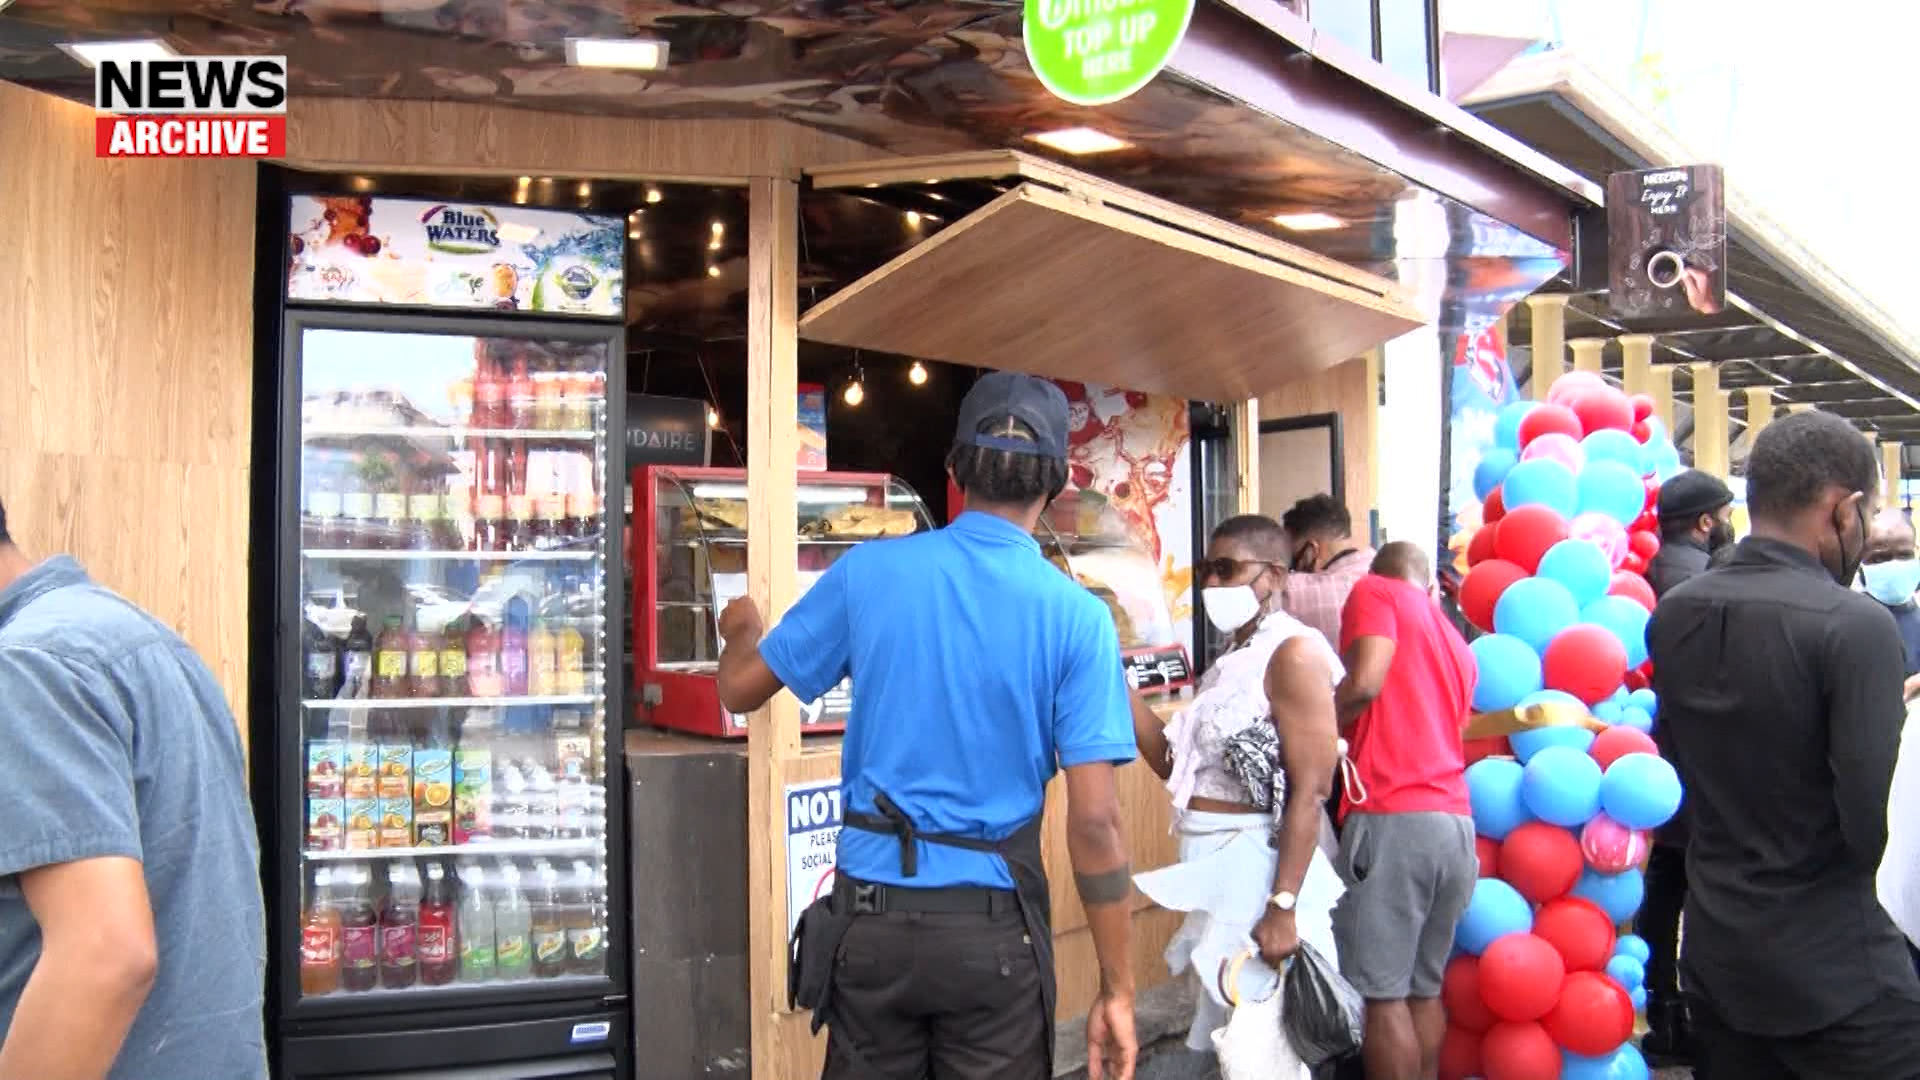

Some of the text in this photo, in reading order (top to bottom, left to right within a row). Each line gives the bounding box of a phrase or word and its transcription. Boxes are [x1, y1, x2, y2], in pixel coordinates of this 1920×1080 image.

[1062, 21, 1112, 60] TOP
[1119, 11, 1157, 46] UP
[442, 211, 486, 226] Blue
[426, 225, 501, 246] WATERS
[626, 428, 696, 452] IDAIRE
[791, 789, 841, 828] NOT
[810, 831, 841, 847] PLEAS
[801, 852, 832, 870] SOCIAL
